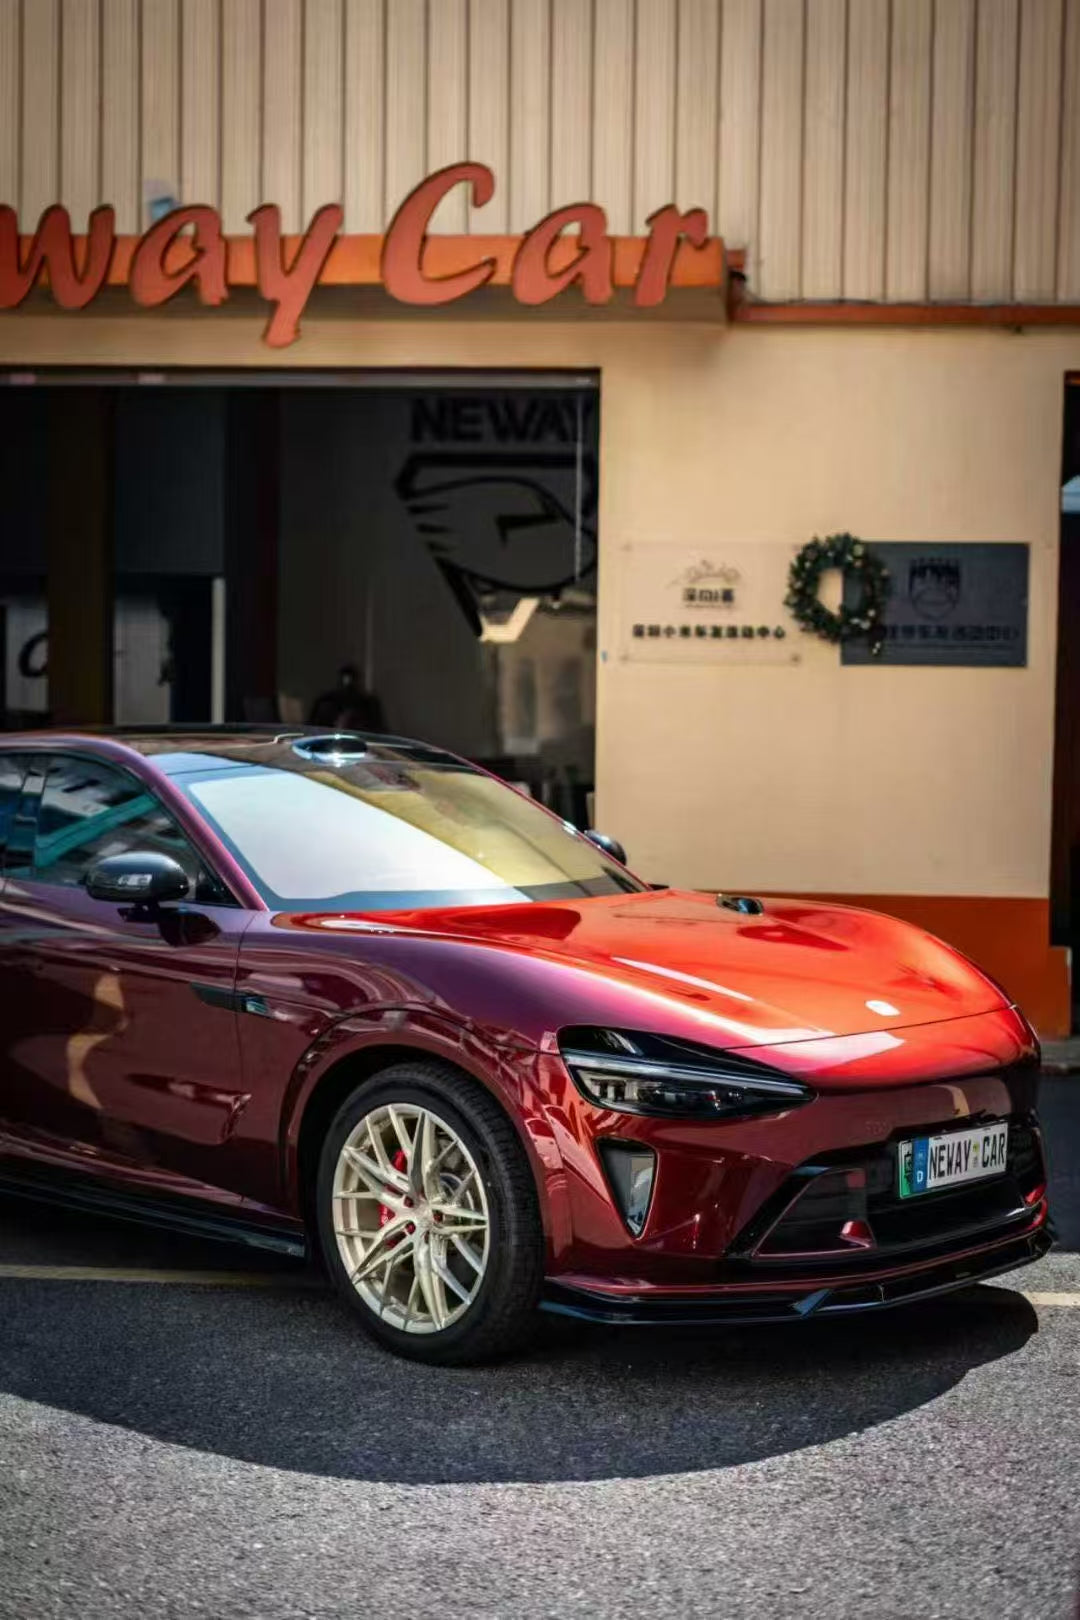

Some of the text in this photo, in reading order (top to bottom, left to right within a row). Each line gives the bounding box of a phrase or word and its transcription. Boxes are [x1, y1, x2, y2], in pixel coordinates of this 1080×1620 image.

[0, 161, 710, 348] way Car
[928, 1139, 972, 1180] NEWAY
[982, 1132, 1006, 1168] CAR
